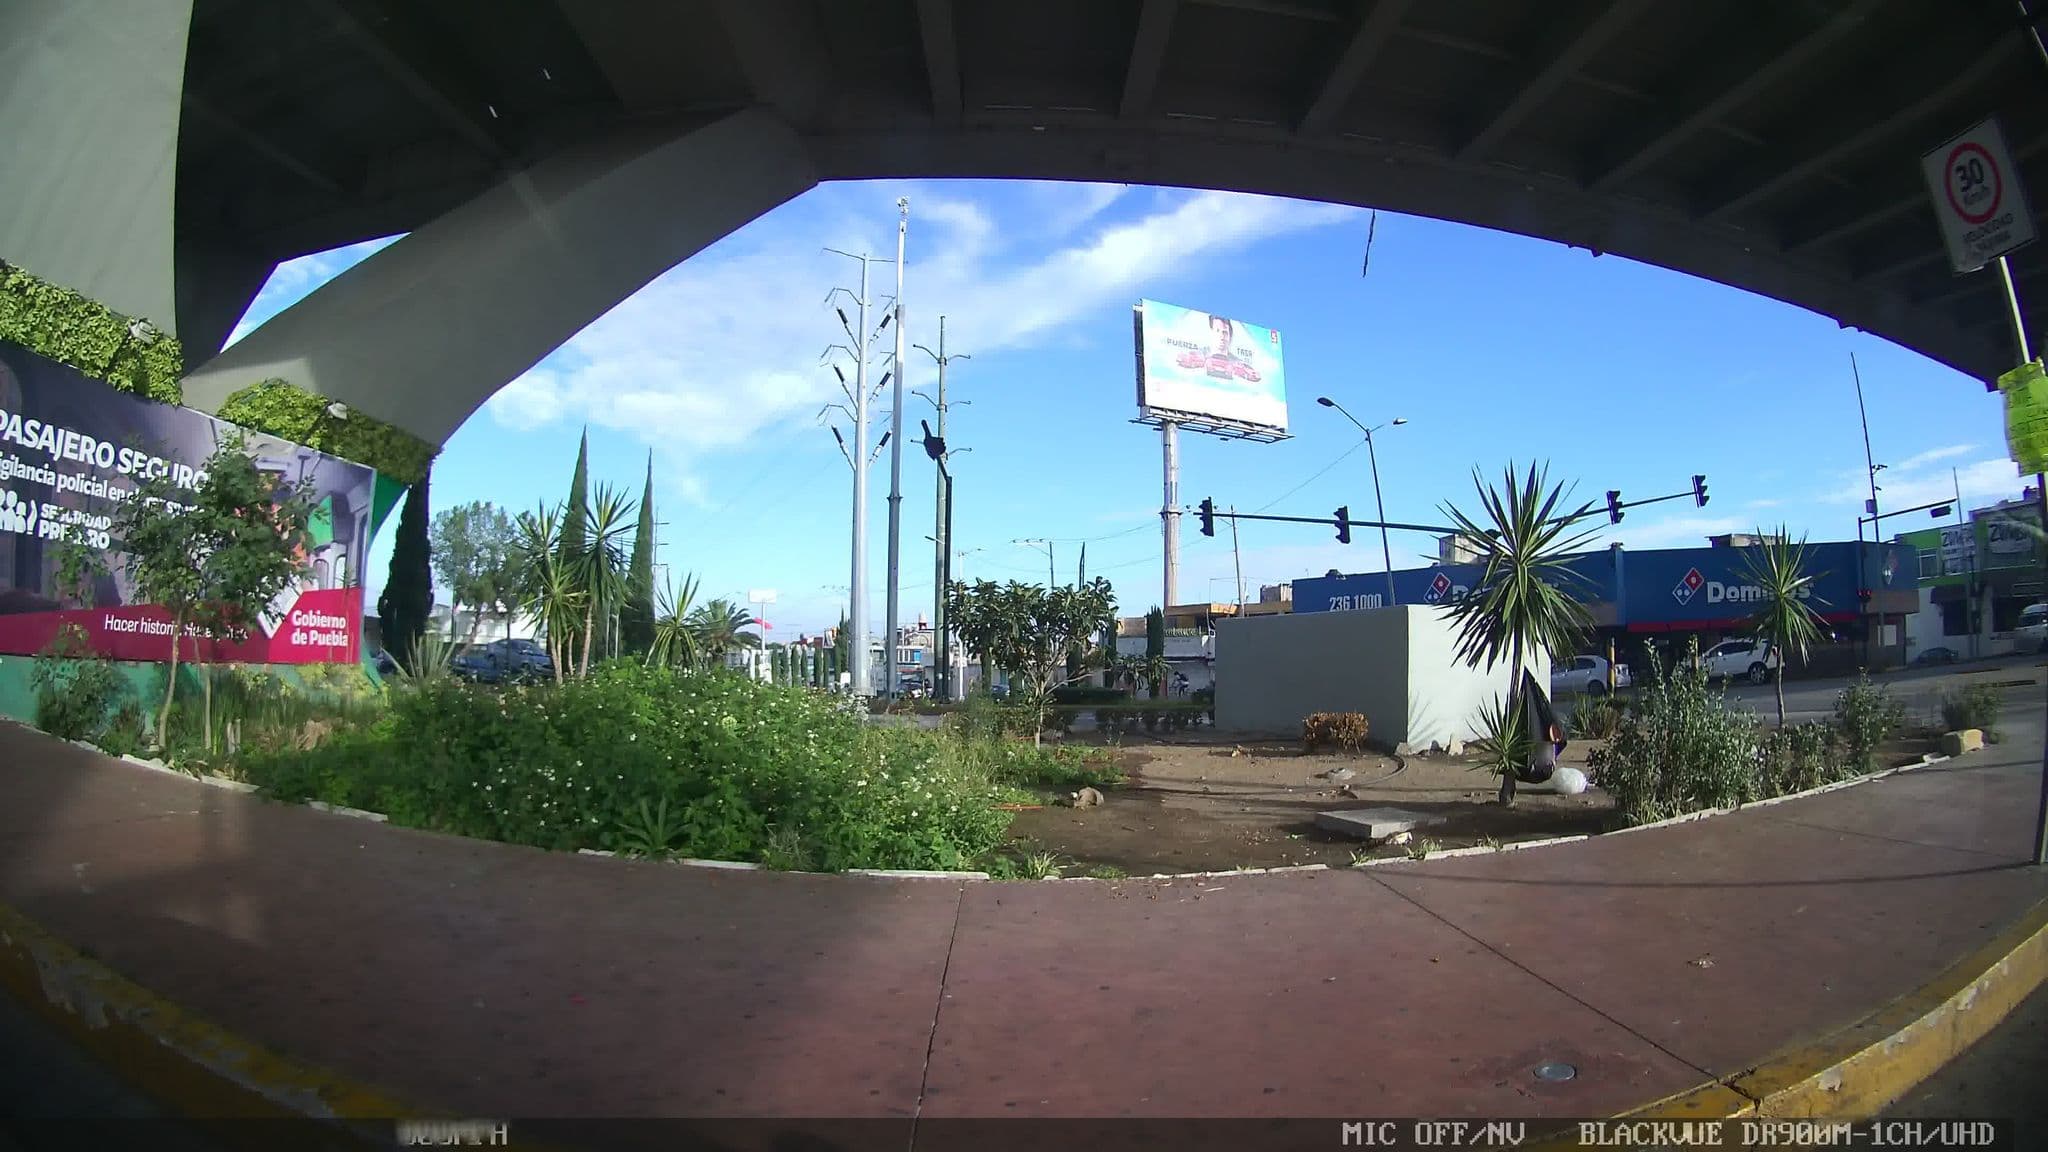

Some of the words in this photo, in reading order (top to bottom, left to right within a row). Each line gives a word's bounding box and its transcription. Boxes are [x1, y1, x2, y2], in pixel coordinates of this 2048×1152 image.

[1956, 158, 1984, 192] 30
[0, 409, 115, 469] PASAJERO
[57, 473, 108, 499] policial
[1329, 596, 1350, 612] 236
[1353, 593, 1382, 610] 1000
[104, 614, 138, 633] Hacer
[140, 617, 182, 636] histori
[292, 609, 347, 629] Gobierno
[291, 630, 308, 645] de
[308, 630, 349, 647] Puebla
